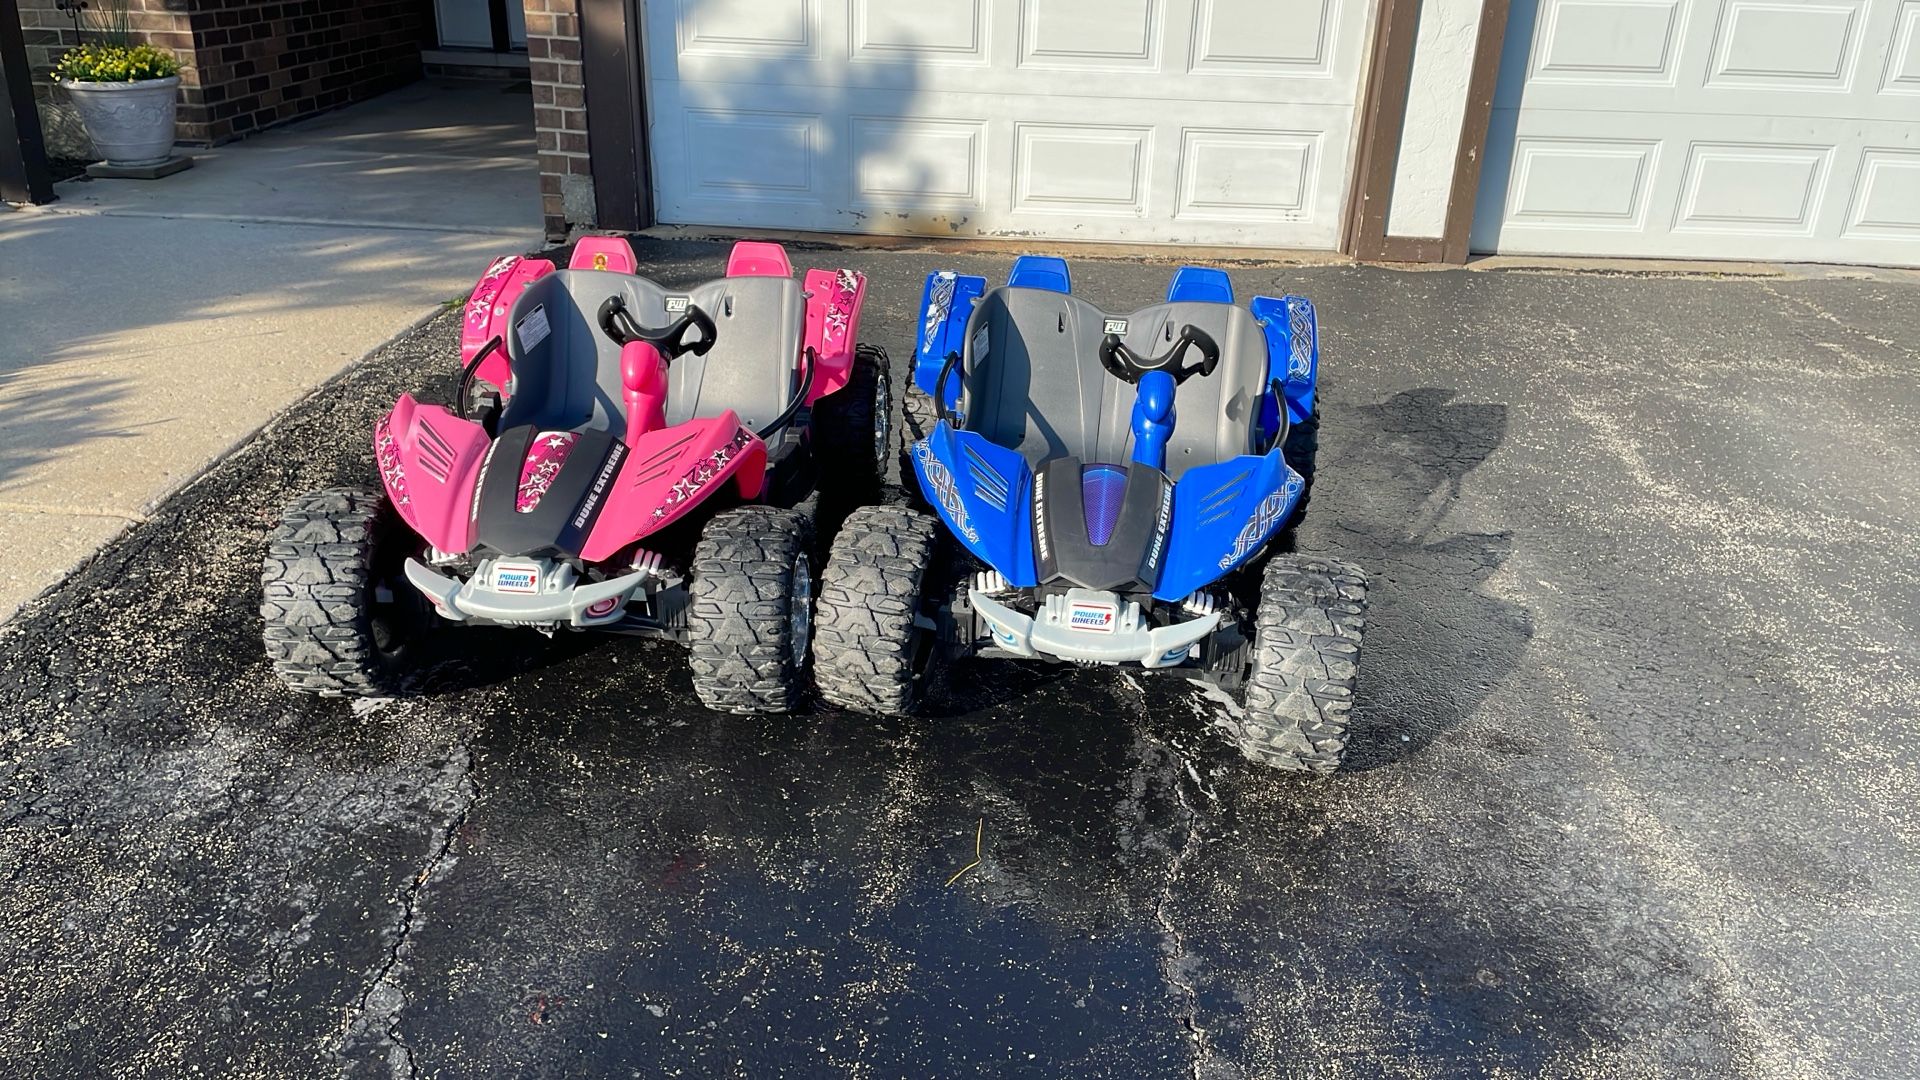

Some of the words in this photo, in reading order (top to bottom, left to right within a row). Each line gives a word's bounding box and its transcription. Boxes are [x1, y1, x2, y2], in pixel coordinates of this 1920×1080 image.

[574, 494, 598, 529] DUNE
[594, 443, 625, 495] EXTREME
[1035, 472, 1044, 502] DUNE
[1035, 503, 1048, 561] EXTREME
[1148, 534, 1164, 569] DUNE
[1157, 483, 1173, 534] EXTREME
[497, 579, 530, 588] WHEELS
[499, 573, 529, 582] POWER
[1071, 616, 1105, 626] WHEELS
[1073, 610, 1104, 619] POWER
